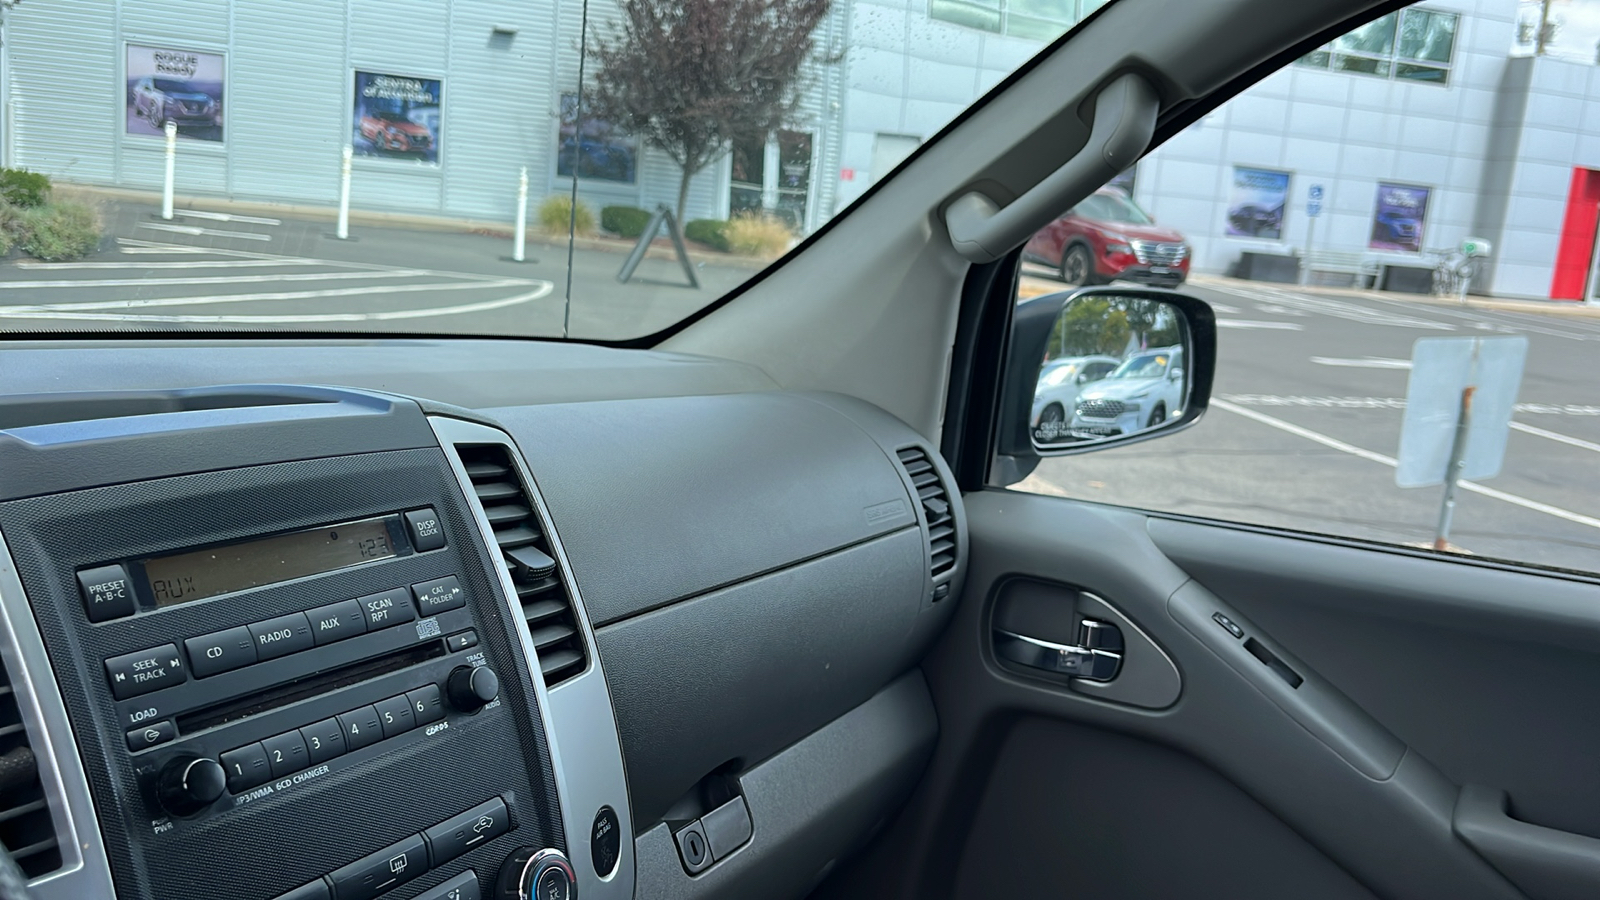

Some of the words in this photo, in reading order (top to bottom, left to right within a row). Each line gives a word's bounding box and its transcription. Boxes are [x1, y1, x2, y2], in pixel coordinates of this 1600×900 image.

[417, 520, 435, 530] DISP
[420, 527, 438, 537] CLOCK
[89, 580, 125, 594] PRESET
[153, 576, 196, 600] AUX
[431, 586, 444, 595] CAT
[367, 598, 393, 612] SCAN
[430, 593, 454, 605] FOLDER
[371, 610, 388, 622] RPT
[320, 617, 340, 630] AUX
[259, 628, 292, 645] RADIO
[206, 646, 223, 659] CD
[466, 652, 485, 663] TRACK
[132, 658, 159, 672] SEEK
[472, 658, 487, 668] TUNE
[133, 668, 166, 683] TRACK
[416, 700, 424, 712] 6
[485, 700, 501, 711] AUDIO
[130, 707, 158, 723] LOAD
[385, 711, 393, 723] 5
[351, 723, 360, 735] 4
[311, 737, 321, 750] 3
[273, 750, 284, 763] 2
[235, 763, 243, 776] 1
[275, 779, 292, 791] 6CD
[293, 765, 330, 784] CHANGER
[153, 821, 174, 834] PWR
